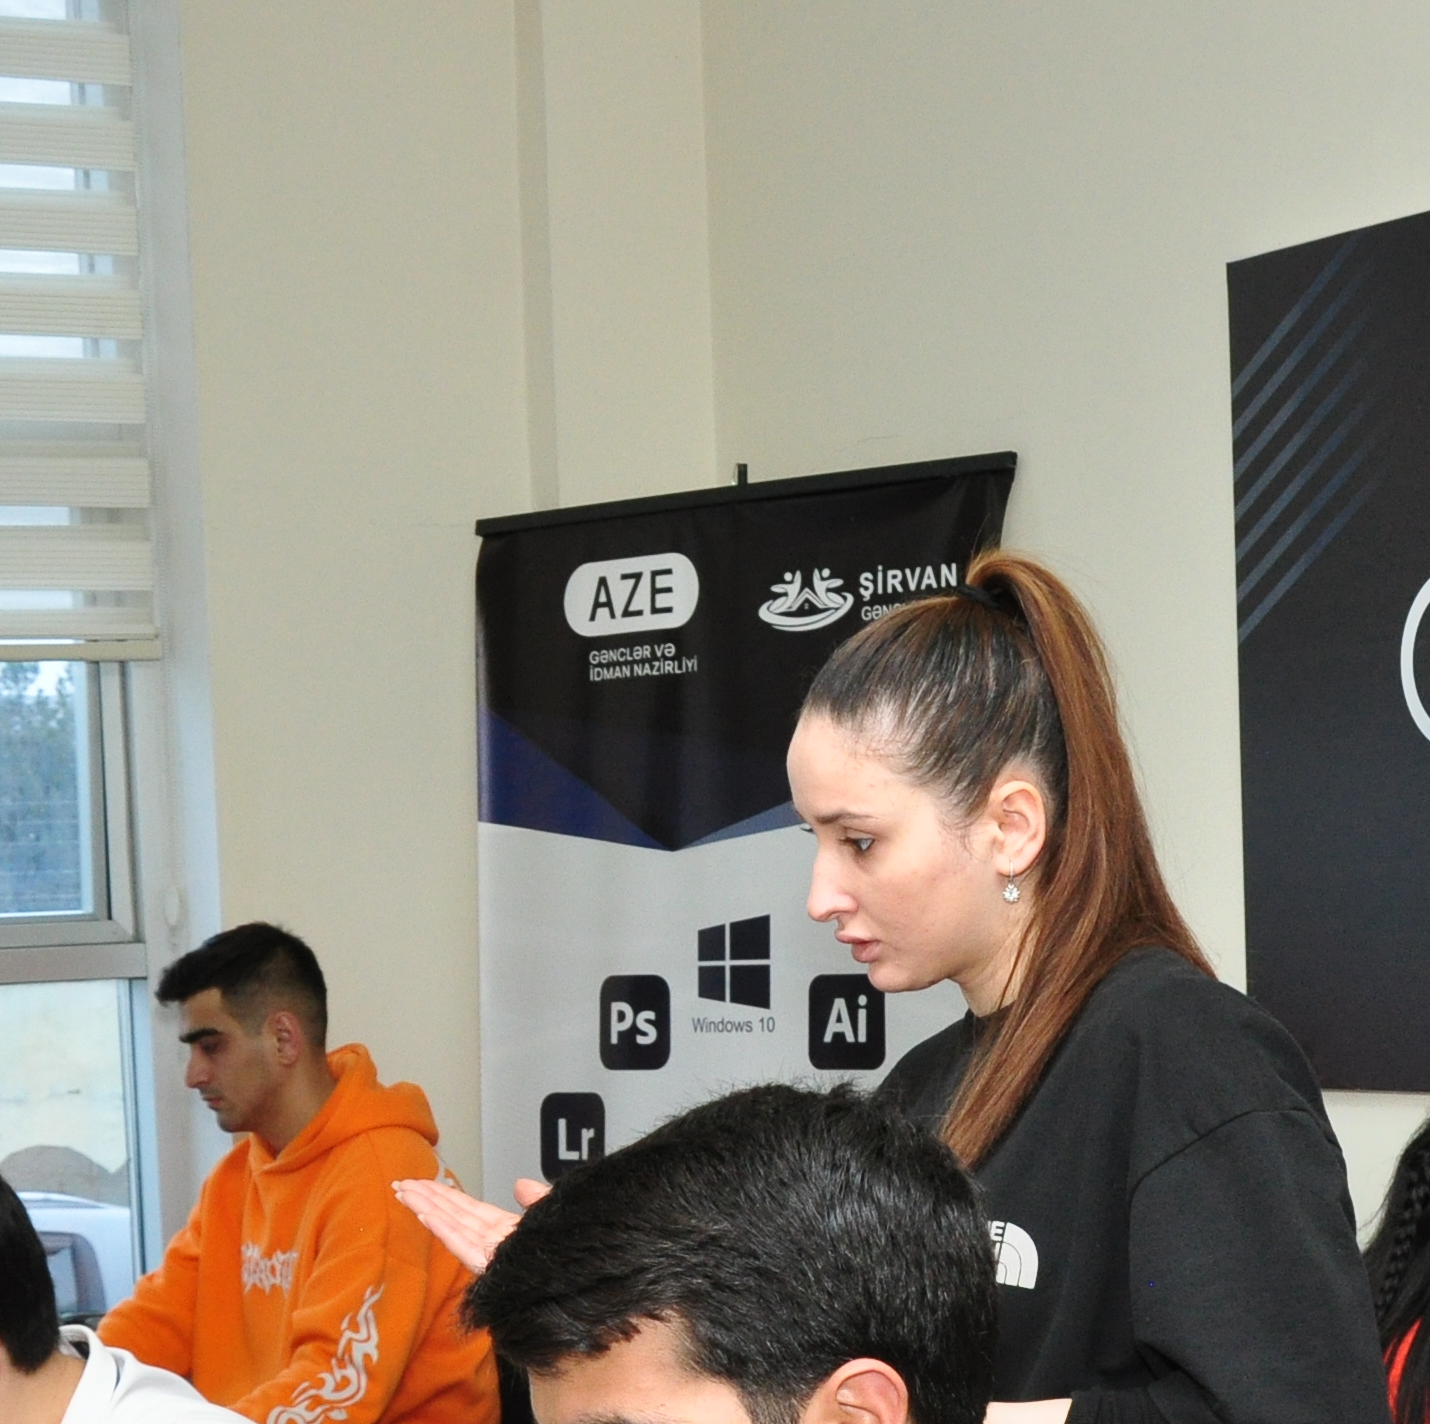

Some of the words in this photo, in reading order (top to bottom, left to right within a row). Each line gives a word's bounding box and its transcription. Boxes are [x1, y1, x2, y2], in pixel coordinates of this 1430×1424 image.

[588, 568, 674, 622] AZE
[858, 562, 958, 602] ŞİRVAN
[588, 645, 652, 665] GƏNCLƏR
[654, 642, 676, 658] VƏ
[589, 664, 631, 682] İDMAN
[633, 655, 698, 677] NAZİRLİYİ
[609, 1001, 658, 1046] Ps
[691, 1015, 753, 1035] Windows
[758, 1015, 776, 1034] 10
[823, 994, 868, 1044] Ai
[557, 1117, 595, 1161] Lr
